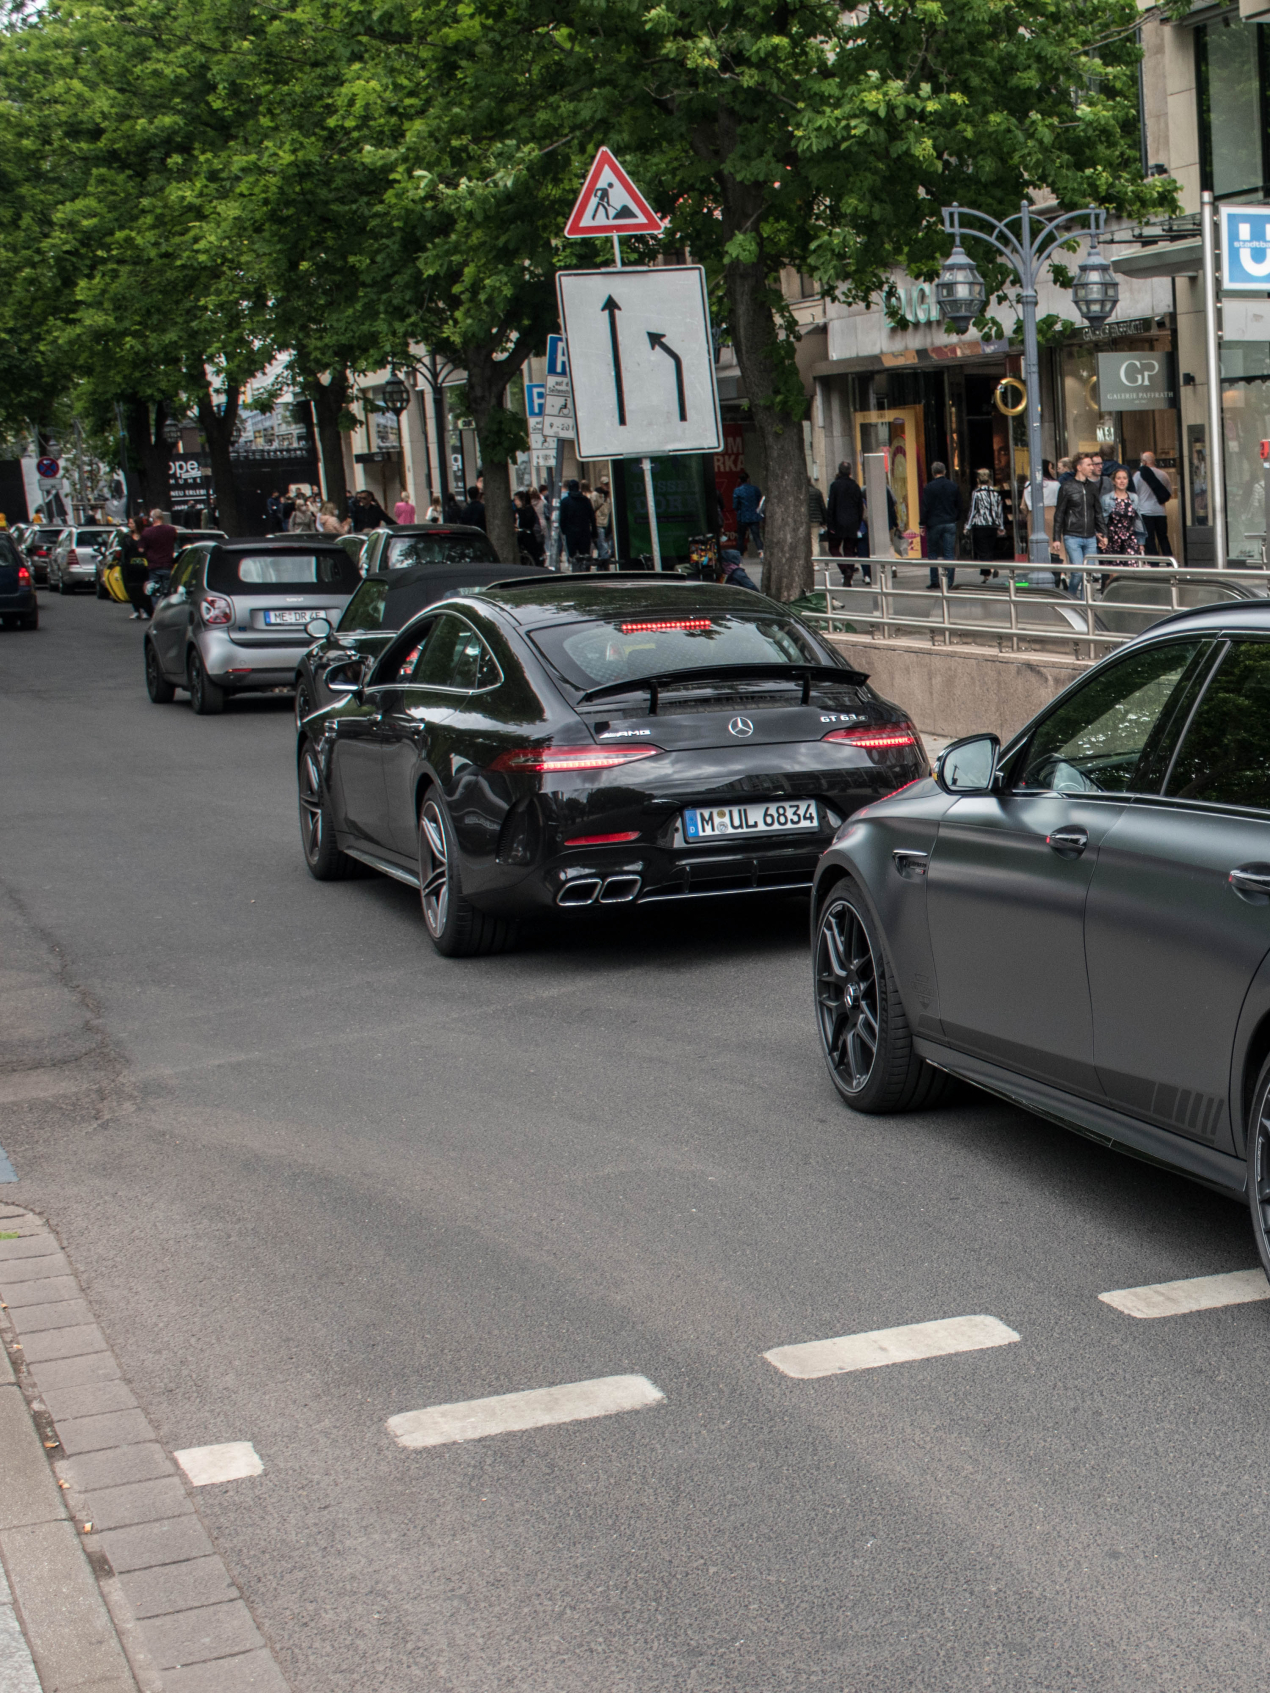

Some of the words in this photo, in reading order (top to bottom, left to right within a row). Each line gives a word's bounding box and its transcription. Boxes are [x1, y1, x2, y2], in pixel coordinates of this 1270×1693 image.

[1120, 360, 1159, 386] GP
[1107, 392, 1137, 400] GALERIE
[1138, 391, 1174, 399] PAFFRATH
[294, 611, 307, 622] DR
[840, 713, 857, 721] 63
[700, 815, 716, 834] M
[728, 812, 757, 831] UL
[763, 803, 815, 827] 6834
